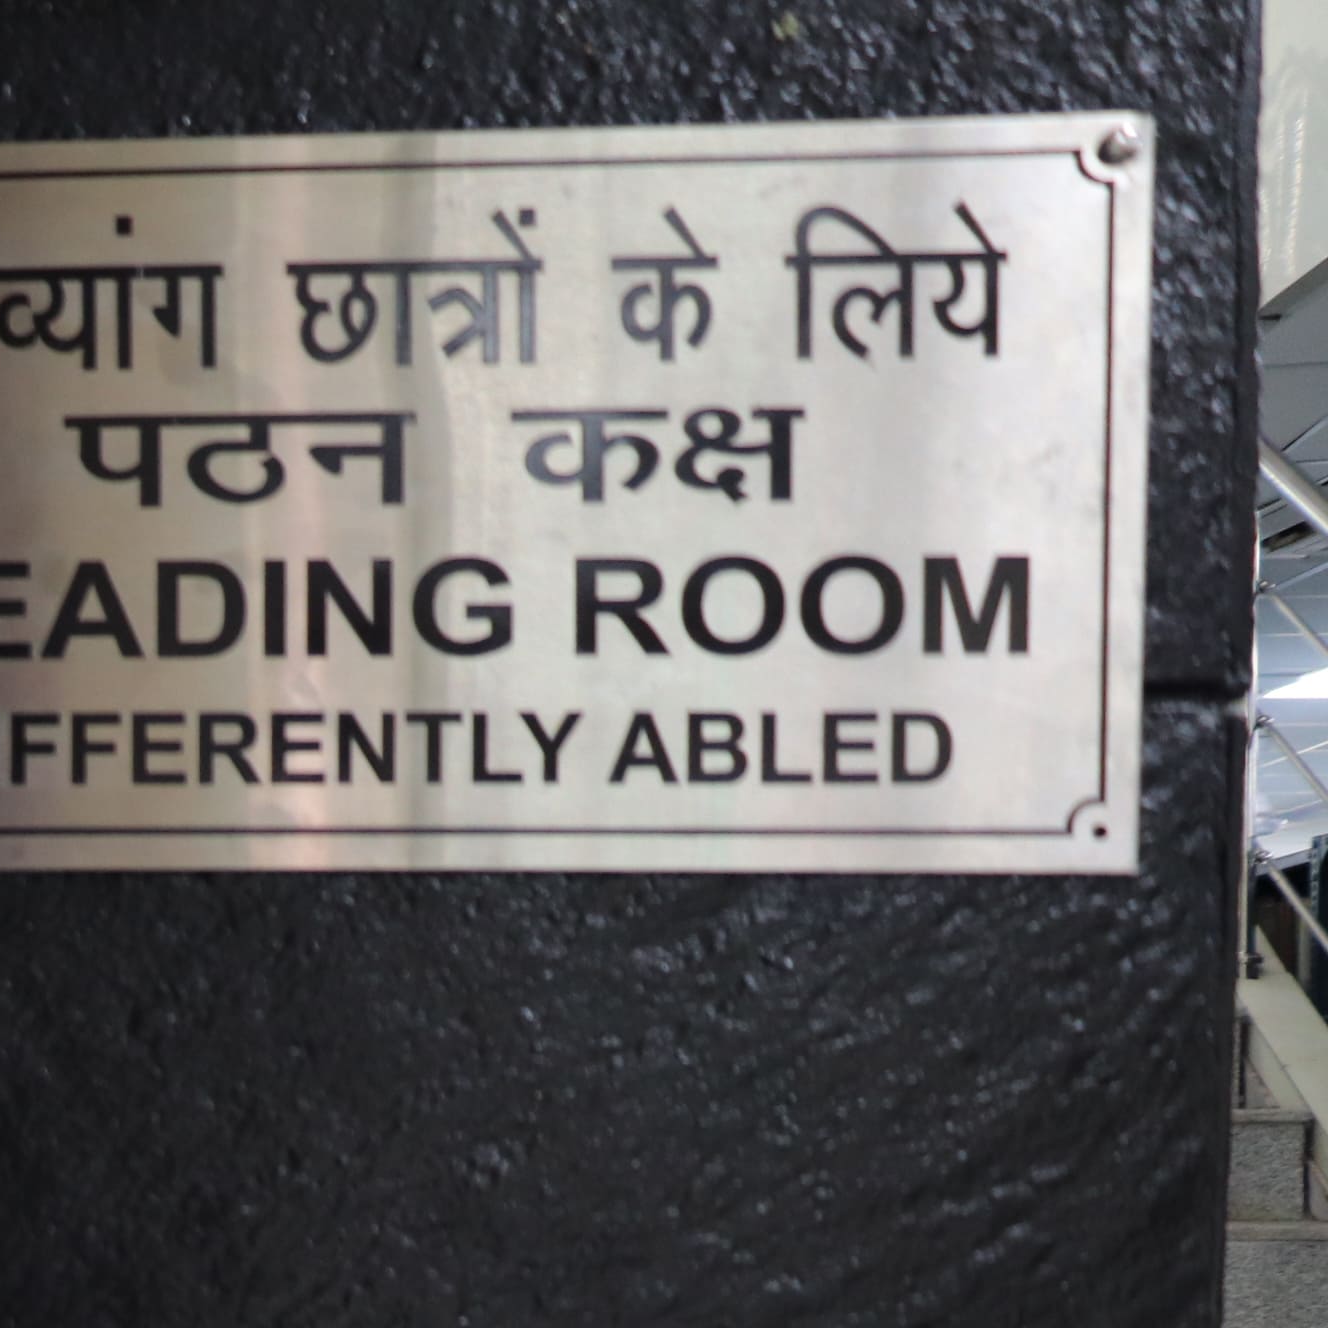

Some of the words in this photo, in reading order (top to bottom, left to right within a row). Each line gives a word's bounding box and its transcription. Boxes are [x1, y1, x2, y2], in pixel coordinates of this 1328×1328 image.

[286, 208, 541, 365] छात्रों
[612, 209, 717, 360] के
[785, 202, 1007, 360] लिये
[62, 411, 417, 508] पठन
[511, 407, 805, 503] कक्ष
[575, 555, 1030, 657] ROOM
[609, 711, 954, 785] ABLED
